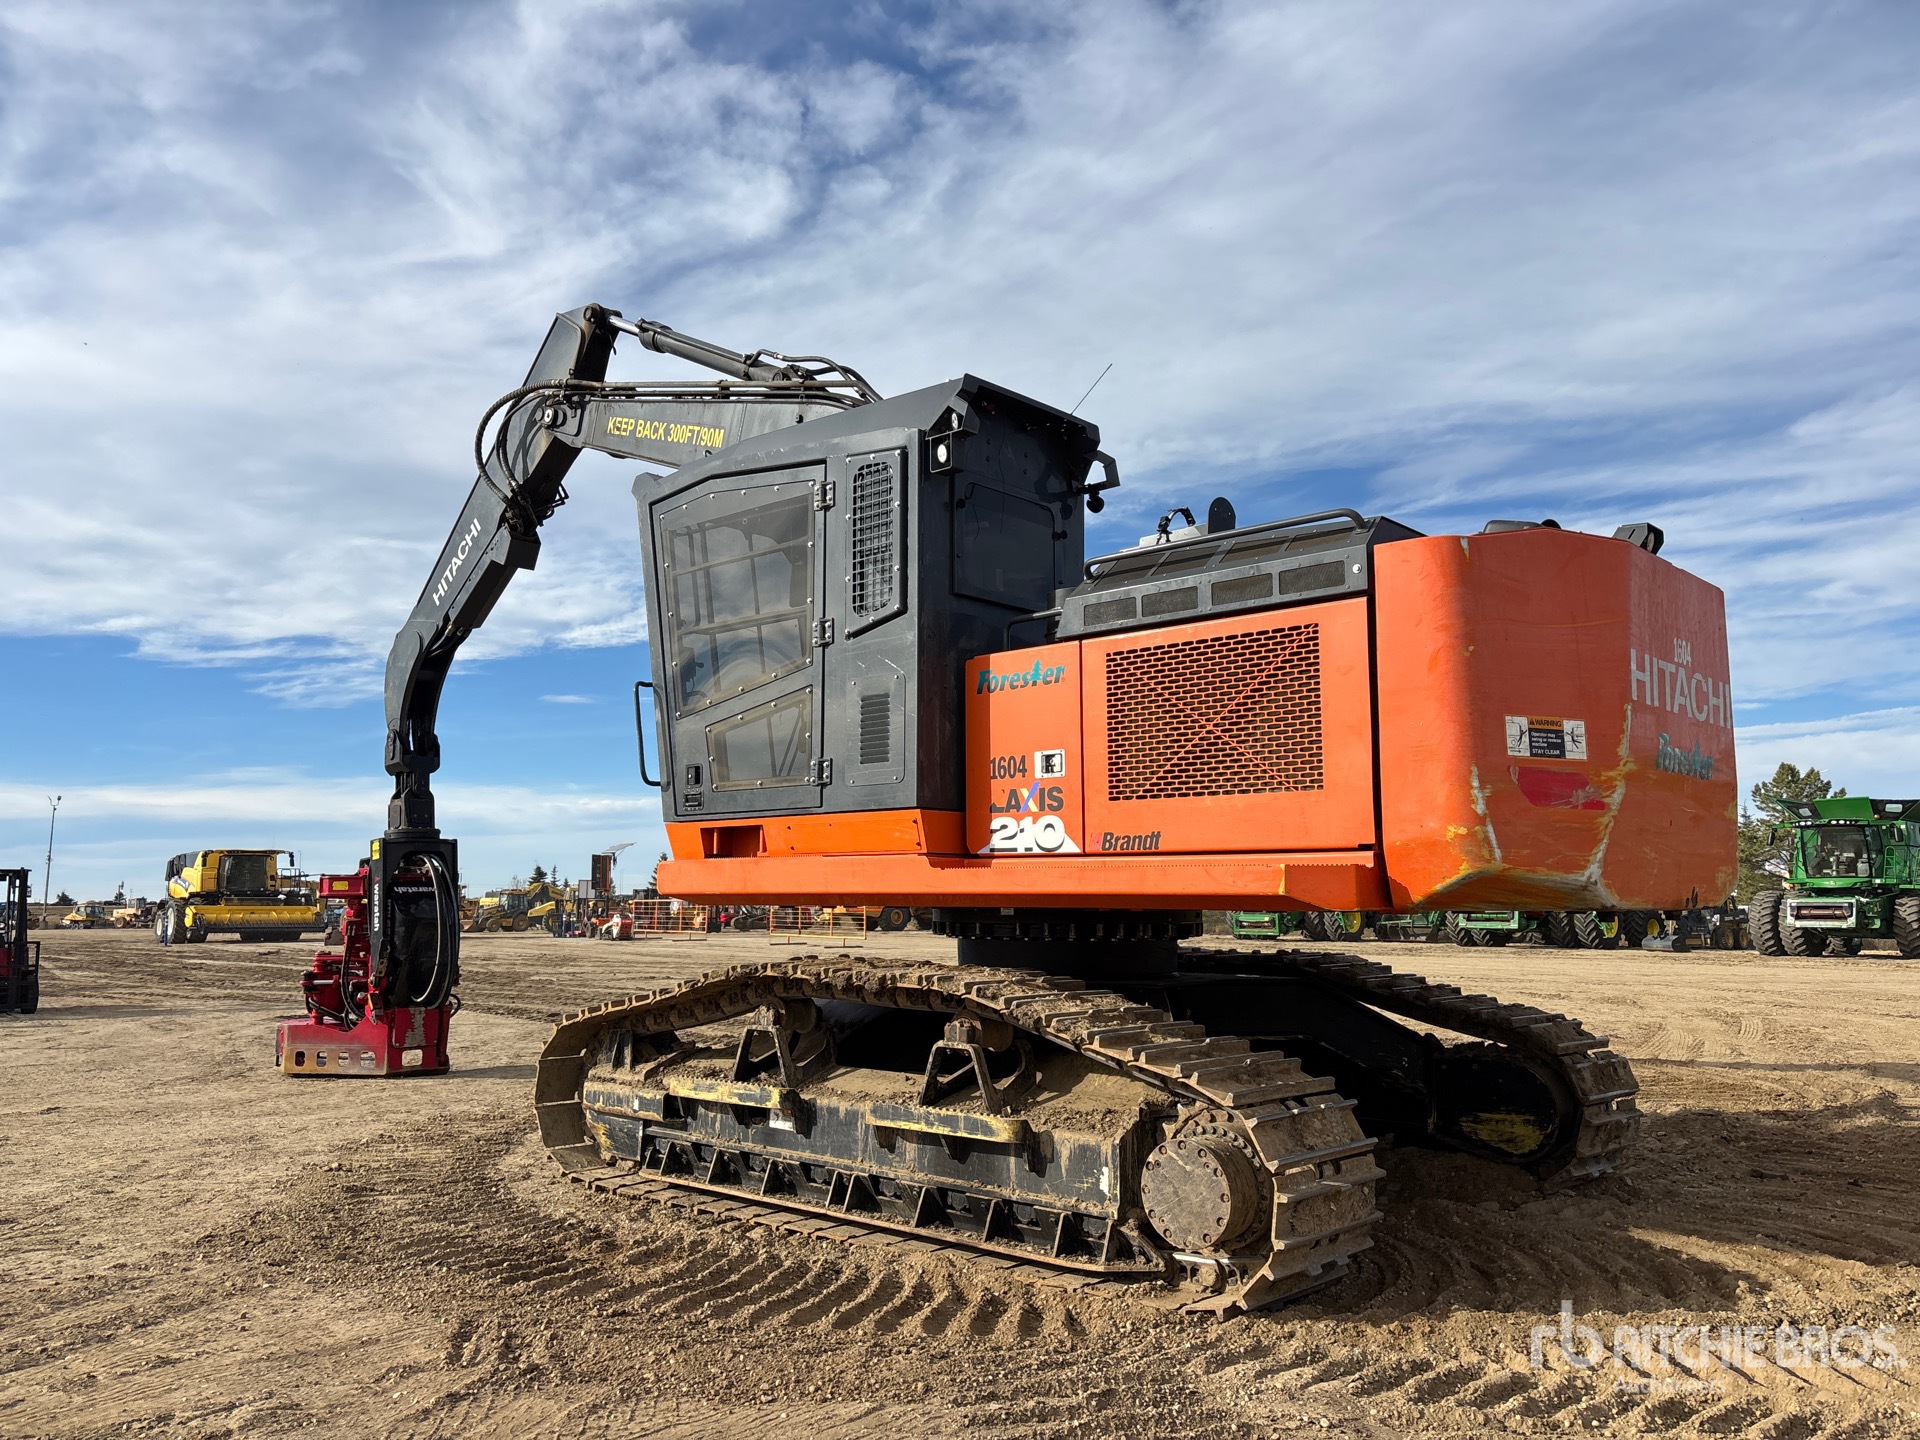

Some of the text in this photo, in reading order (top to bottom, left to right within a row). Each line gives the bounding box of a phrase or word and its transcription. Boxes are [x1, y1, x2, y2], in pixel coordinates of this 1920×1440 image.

[607, 416, 725, 448] KEEP BACK 300FT/90M
[432, 518, 481, 606] HITACHI
[1673, 637, 1692, 667] 1604
[976, 659, 1066, 695] Forester
[1630, 648, 1731, 729] HITACHI
[1535, 719, 1561, 727] WARNING
[990, 755, 1027, 779] 1604
[990, 815, 1066, 852] 210
[1101, 831, 1161, 851] Brandt
